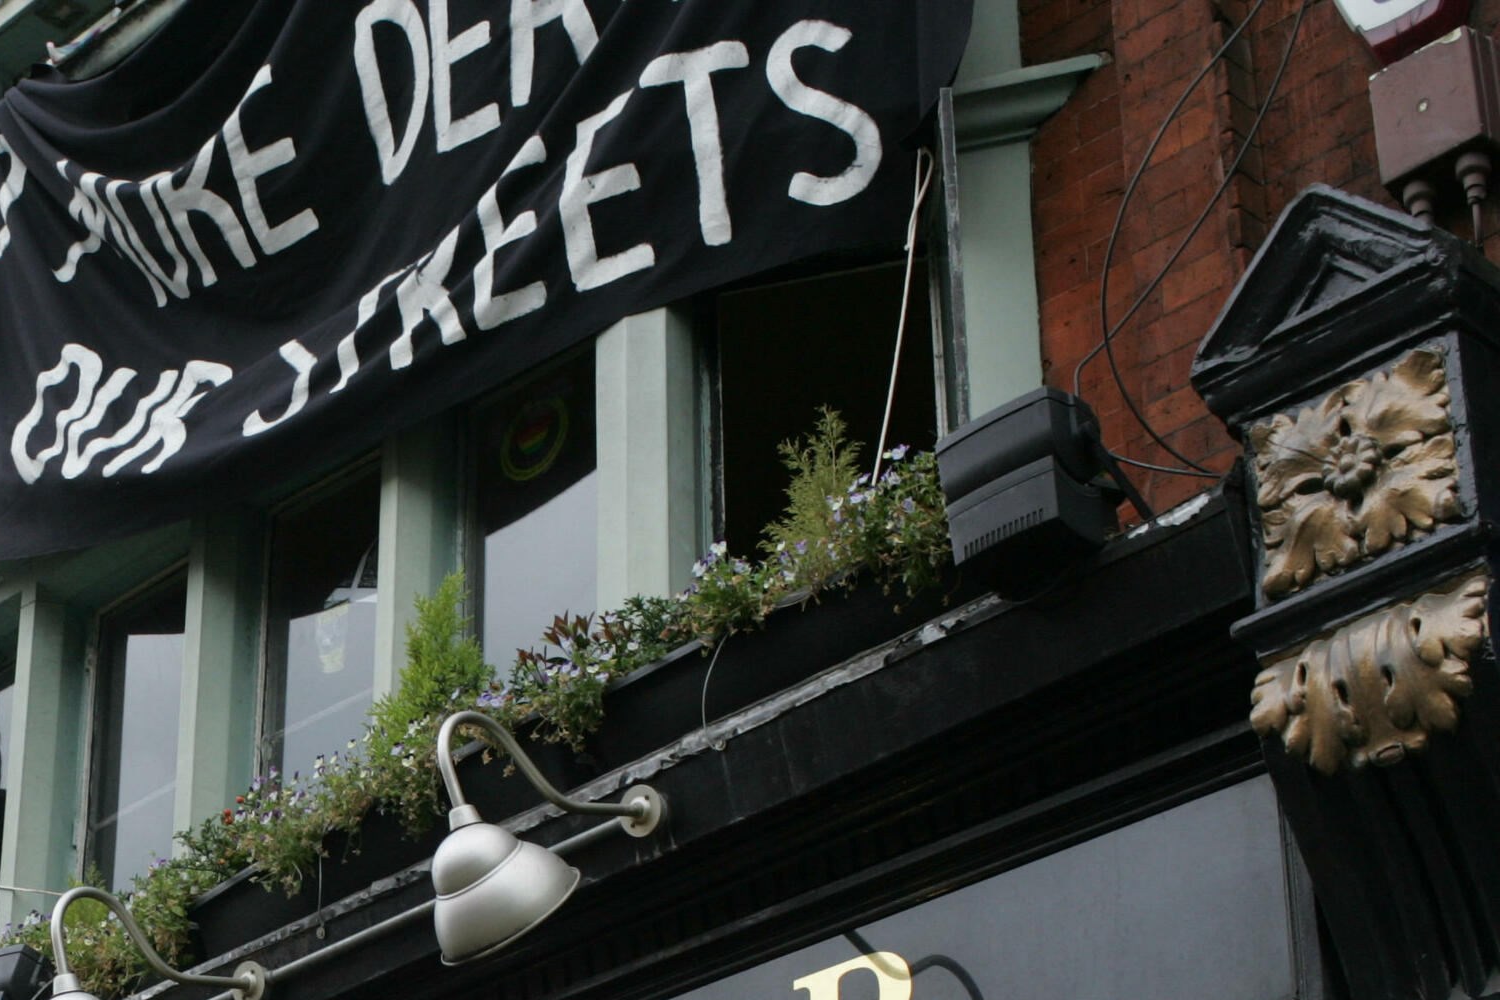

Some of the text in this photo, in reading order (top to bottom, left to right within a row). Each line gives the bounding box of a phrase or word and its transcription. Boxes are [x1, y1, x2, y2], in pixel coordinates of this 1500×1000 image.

[11, 343, 233, 485] OUR
[243, 19, 883, 438] STREETS
[354, 0, 600, 186] DEA
